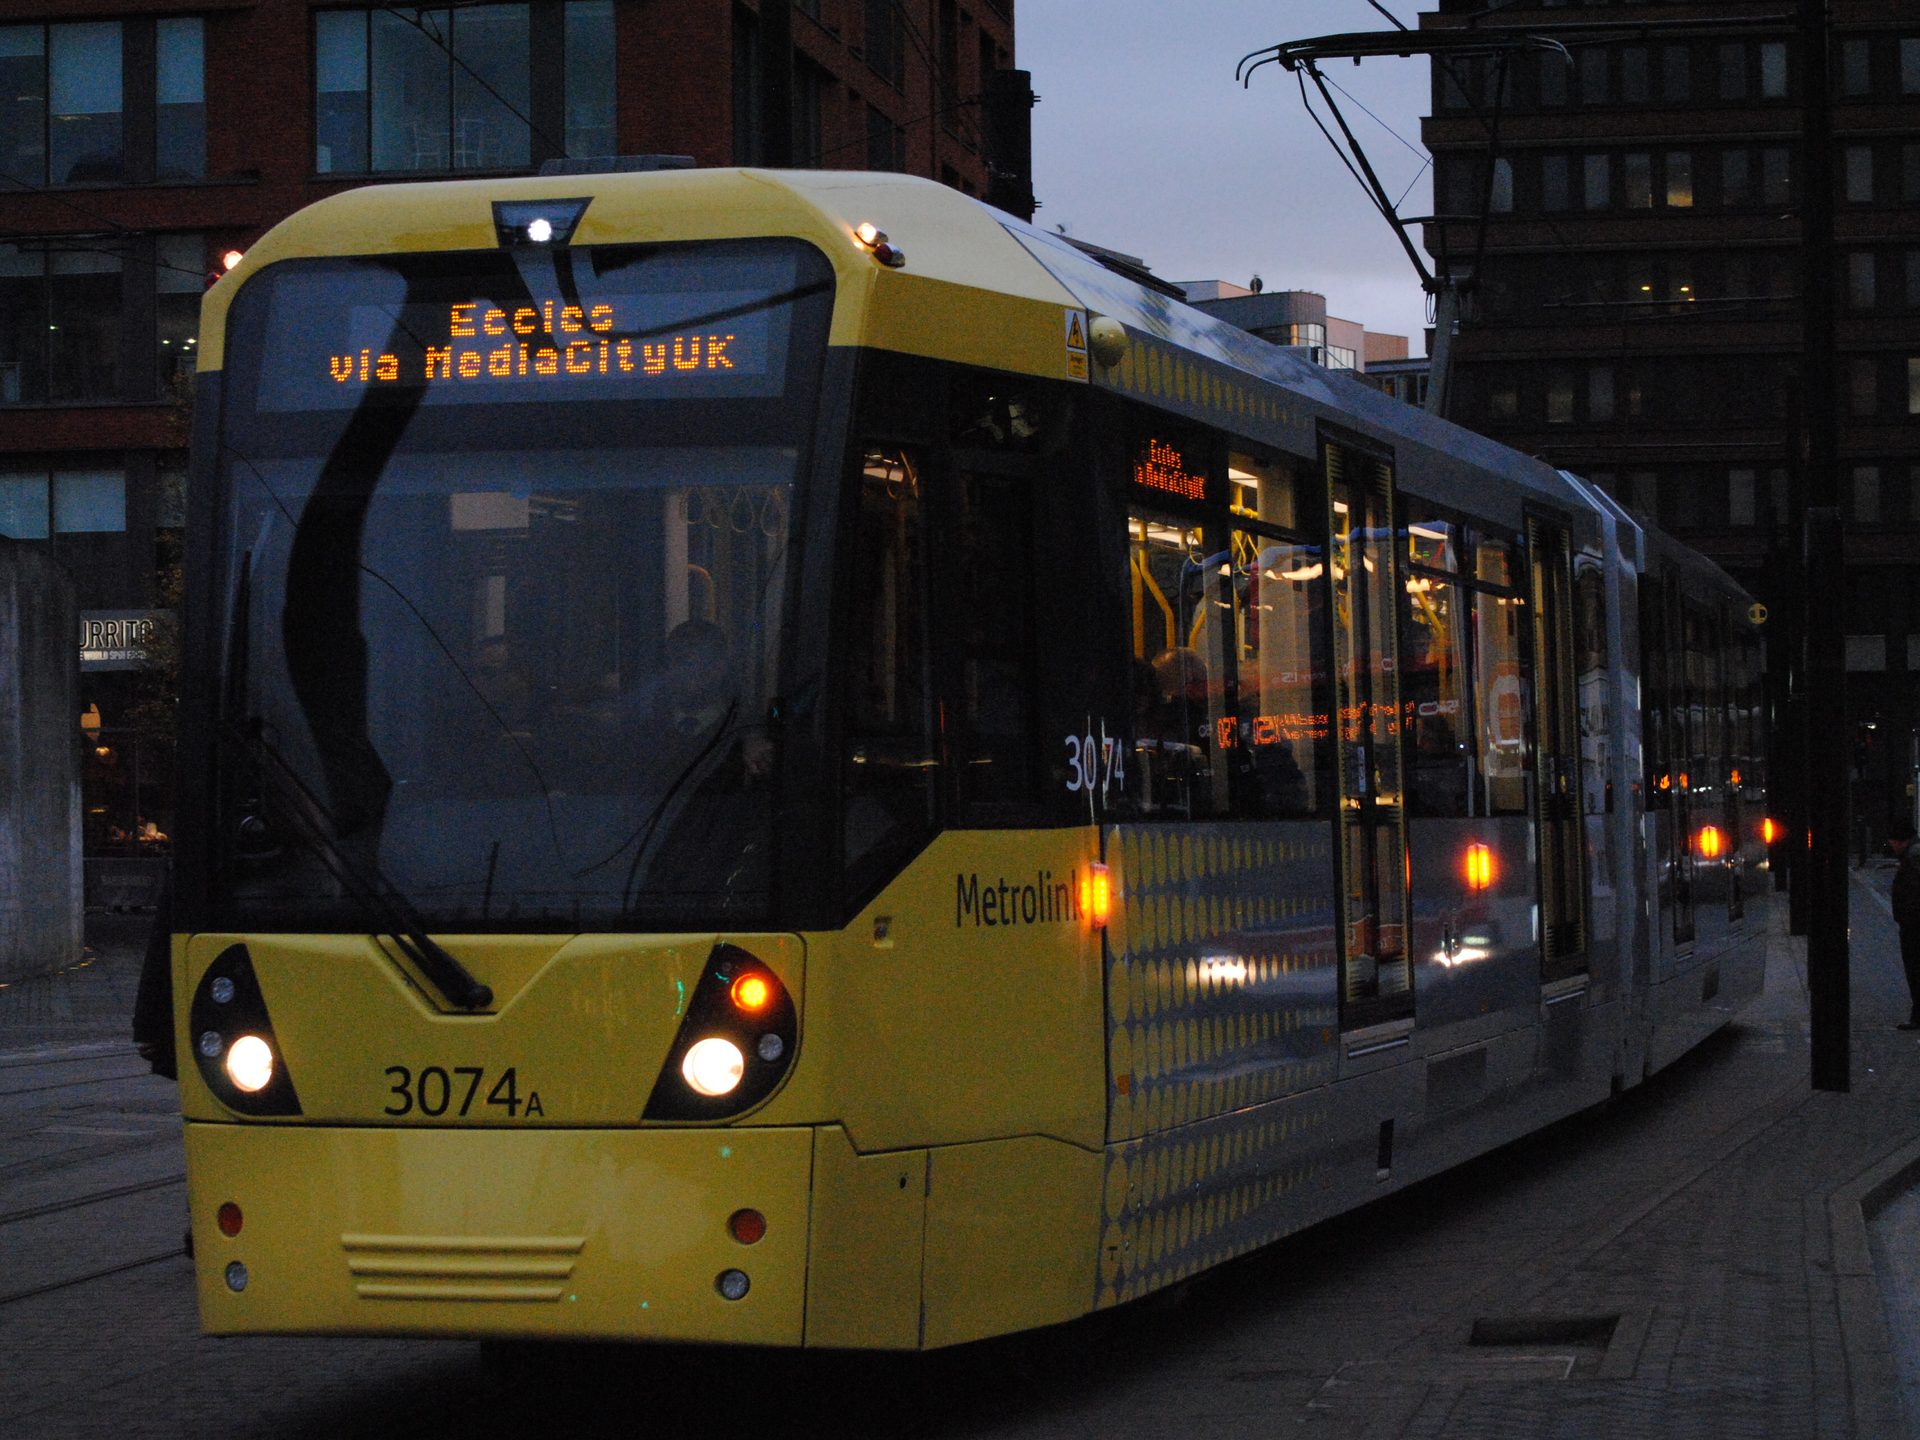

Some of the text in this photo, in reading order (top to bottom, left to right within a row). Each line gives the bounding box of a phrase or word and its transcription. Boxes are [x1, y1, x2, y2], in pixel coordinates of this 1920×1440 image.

[329, 334, 737, 383] via MediaCityUK
[1064, 734, 1125, 791] 3074
